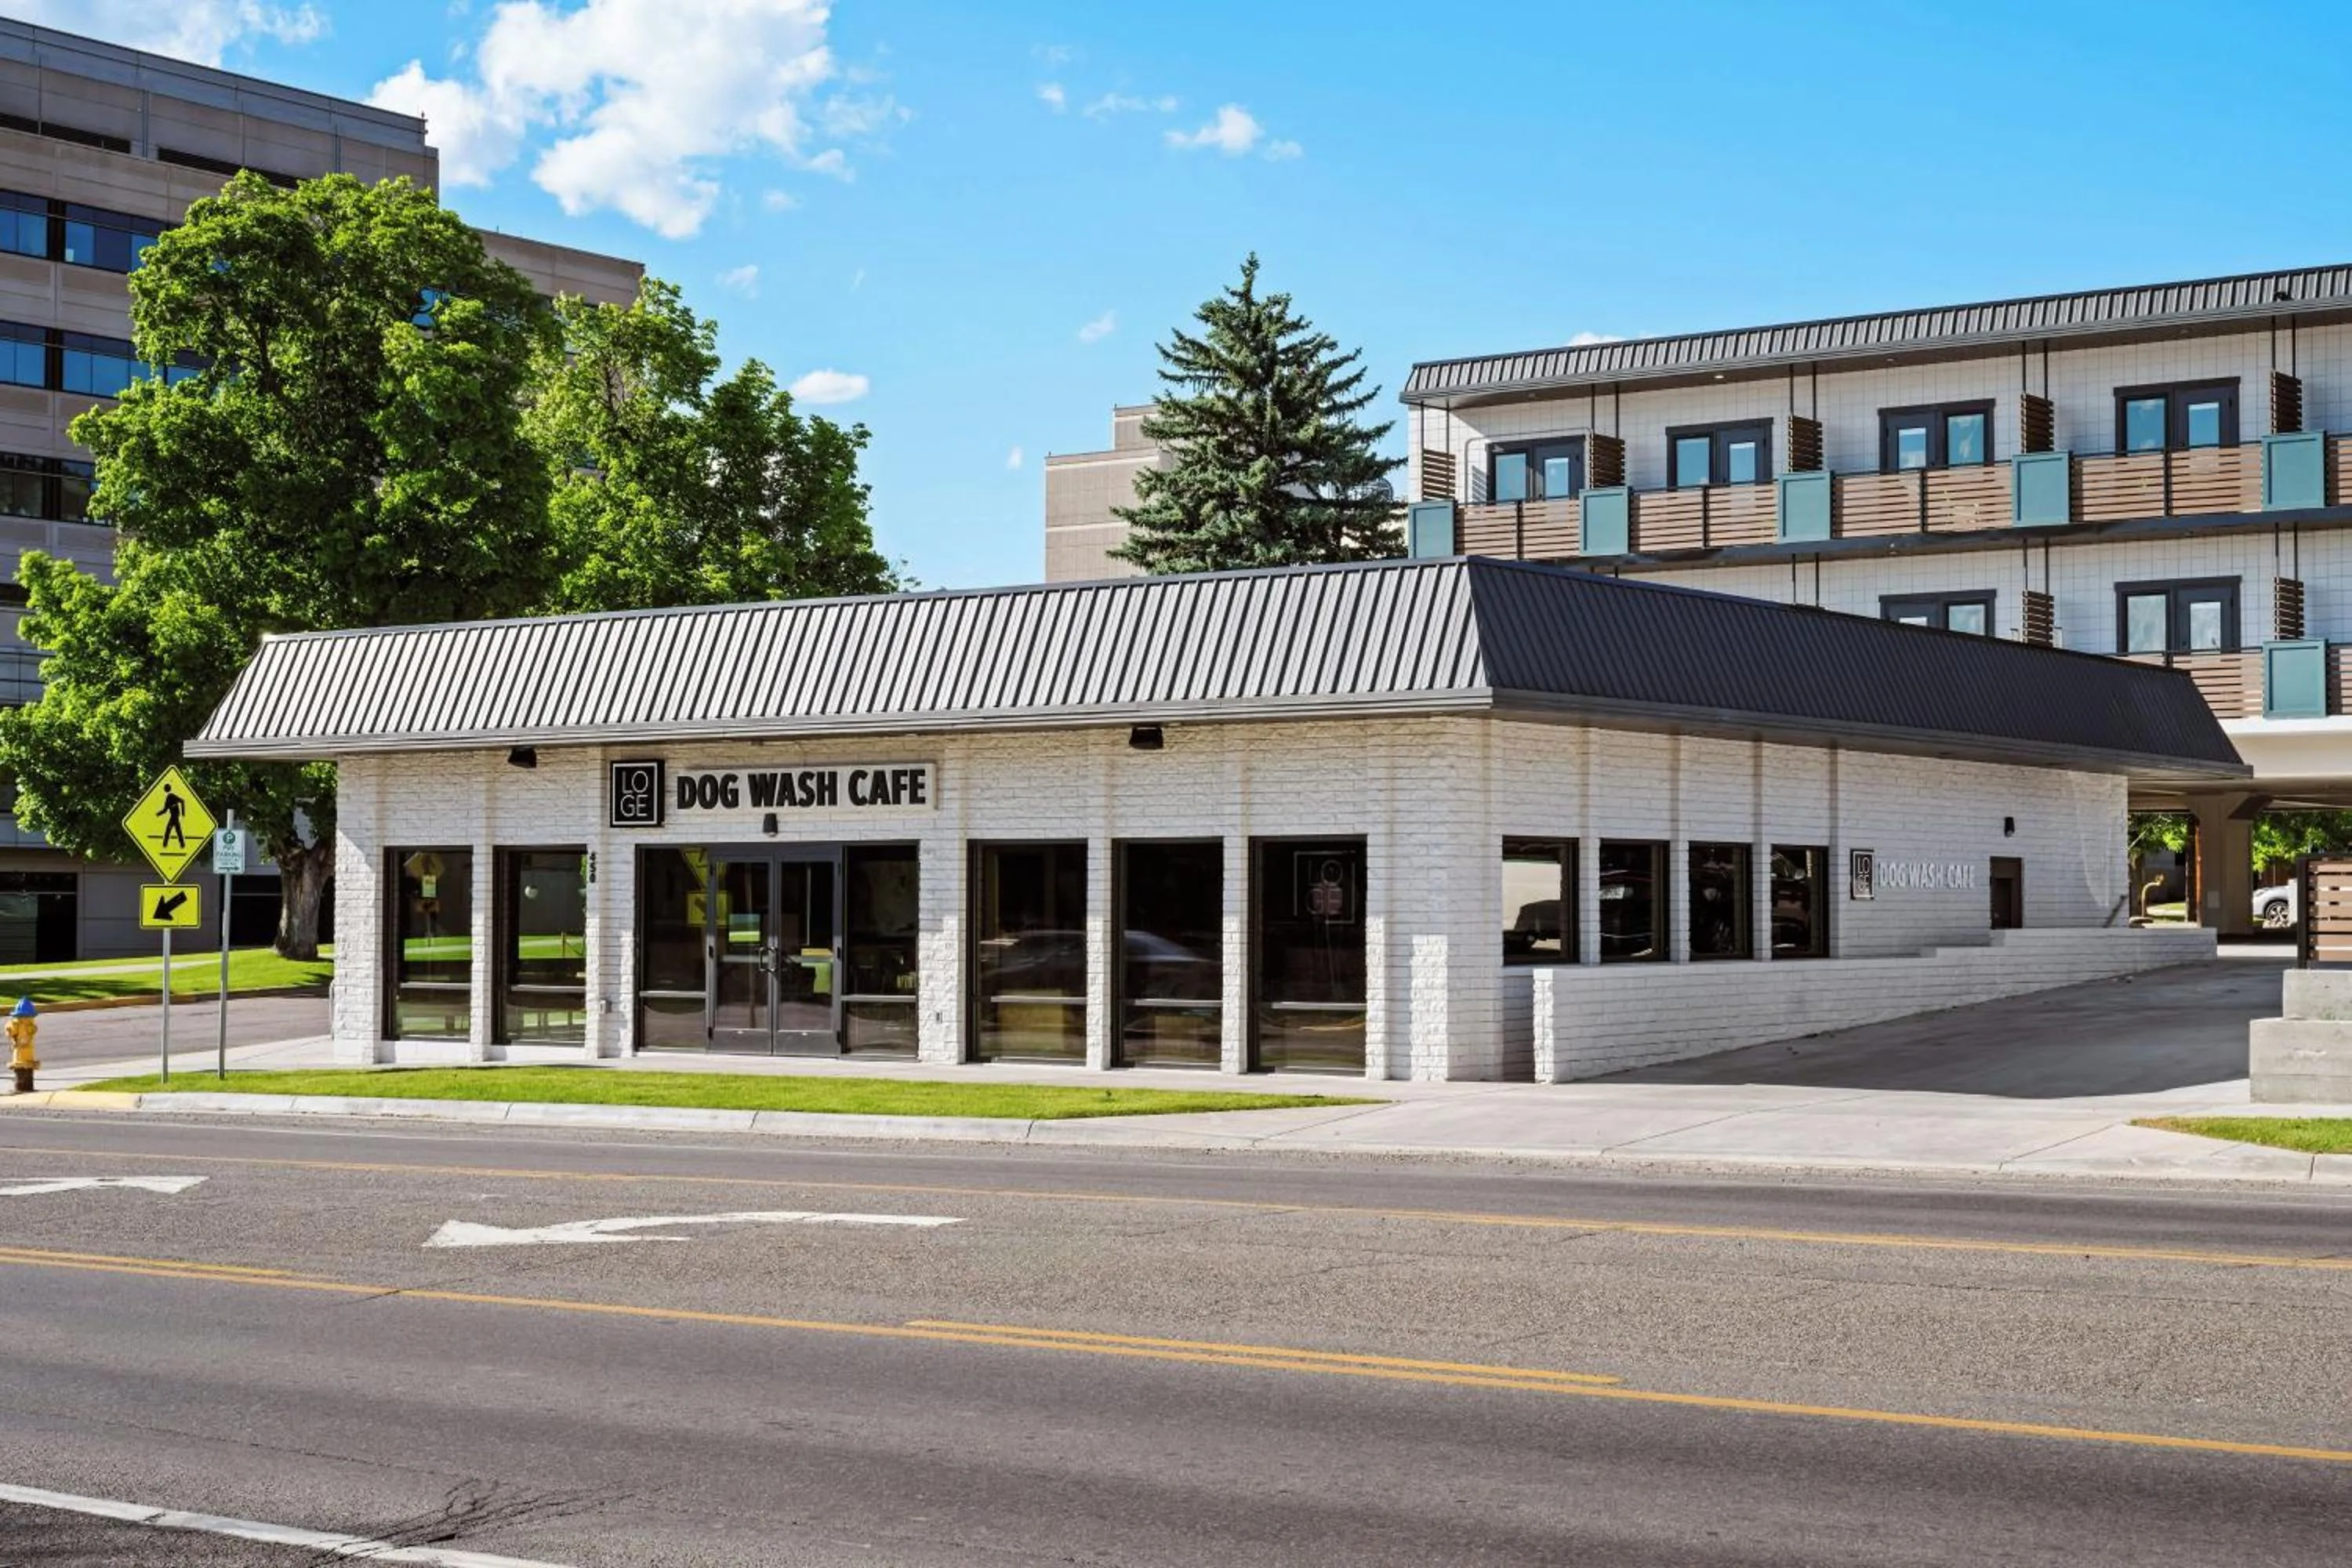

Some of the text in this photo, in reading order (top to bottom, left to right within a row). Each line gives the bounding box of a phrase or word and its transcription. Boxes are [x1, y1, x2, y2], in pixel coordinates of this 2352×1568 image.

[677, 769, 926, 810] DOG WASH CAFE
[1877, 862, 1906, 887] DOG
[1908, 862, 1944, 888] WASH
